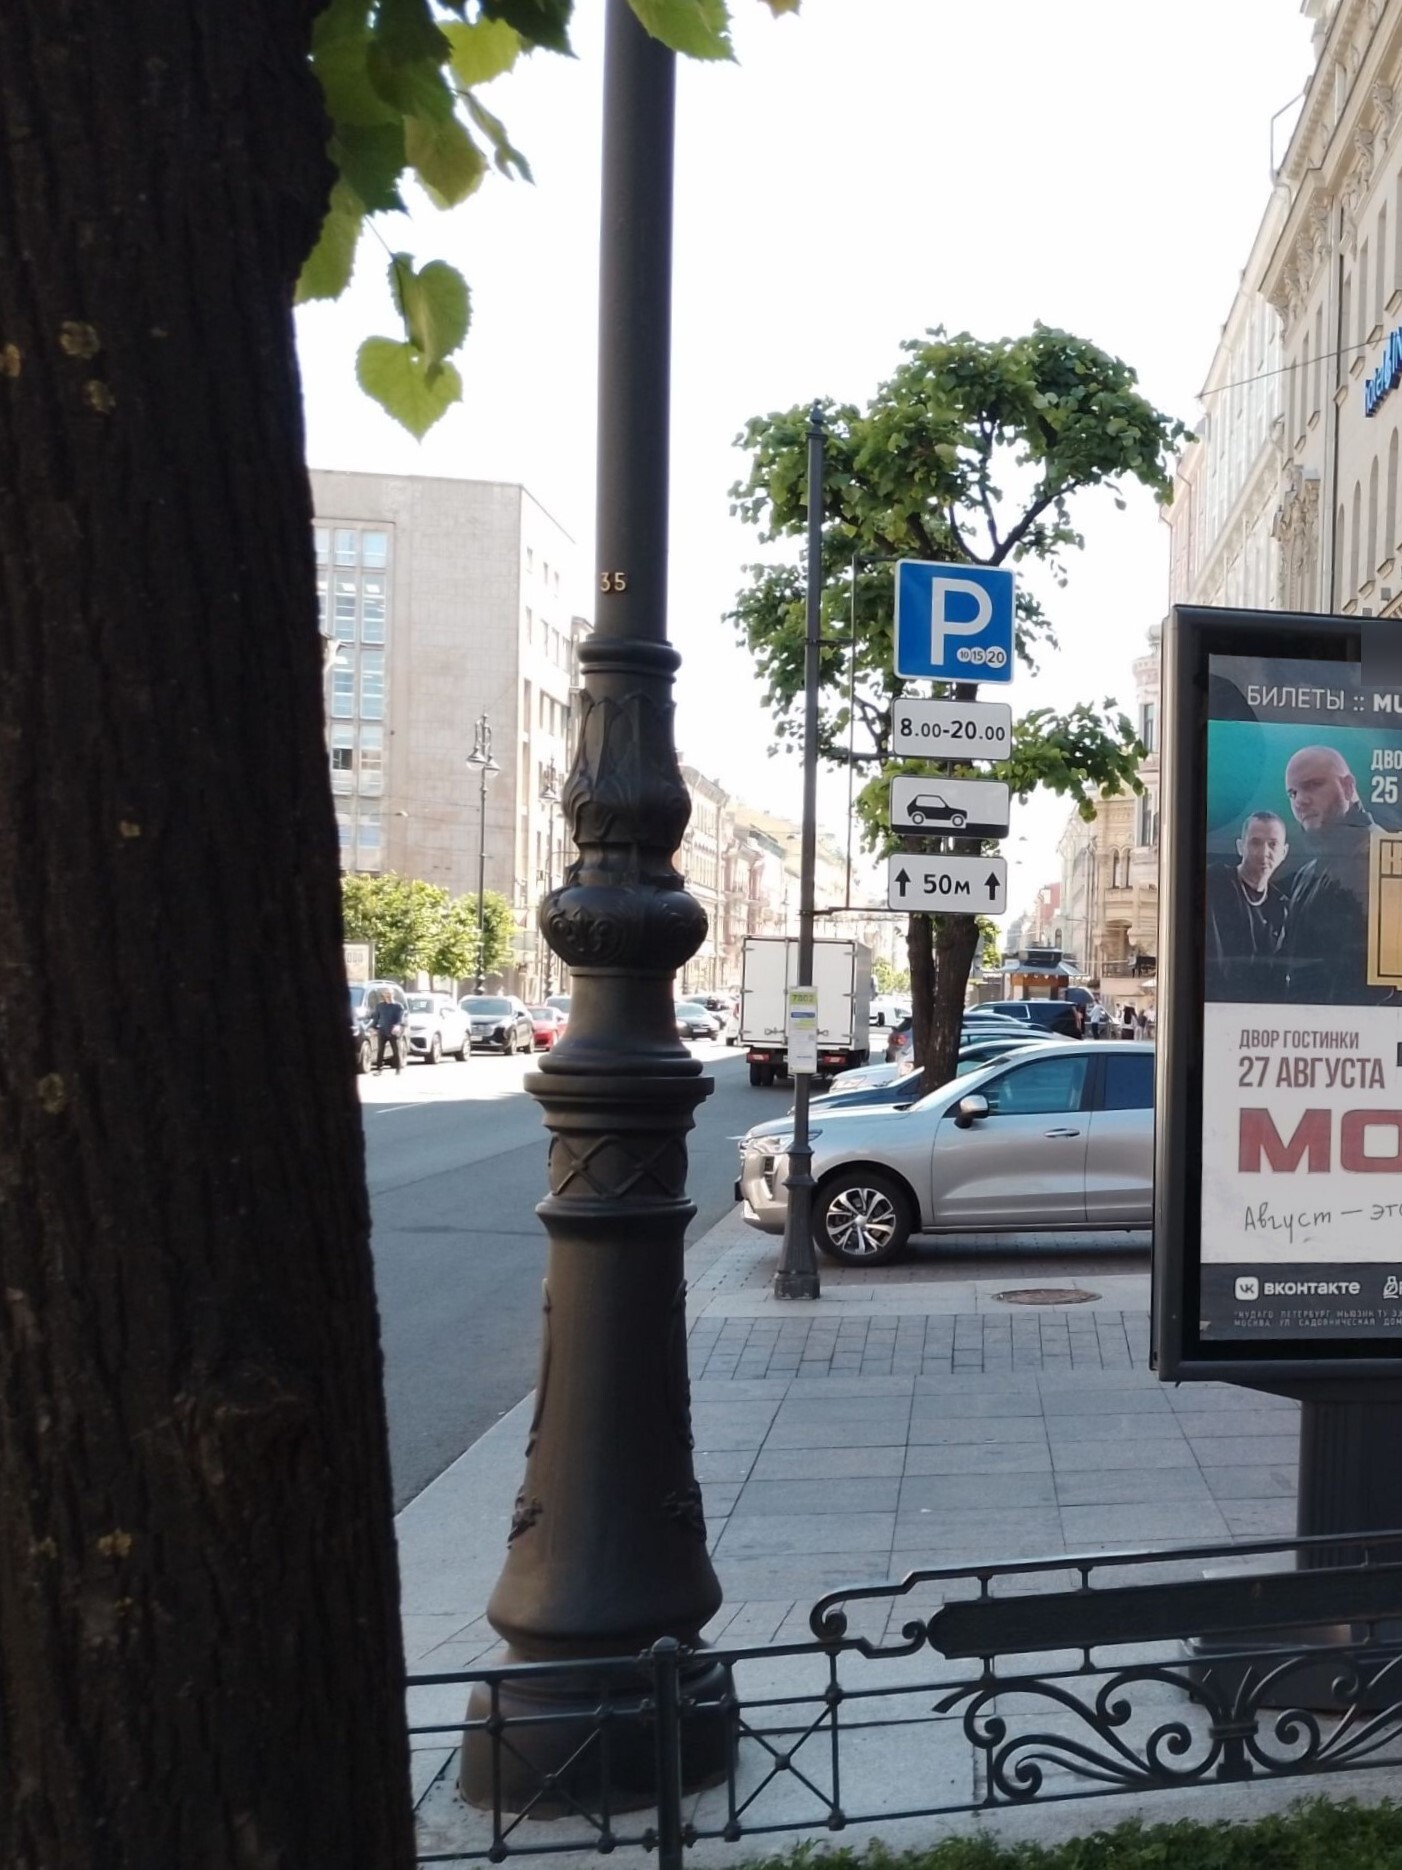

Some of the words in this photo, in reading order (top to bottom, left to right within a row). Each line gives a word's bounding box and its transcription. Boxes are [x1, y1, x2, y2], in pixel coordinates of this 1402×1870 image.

[600, 572, 626, 592] 35
[930, 576, 993, 665] P
[960, 651, 970, 659] 10
[972, 651, 984, 661] 15
[988, 651, 1005, 664] 20
[1247, 685, 1344, 710] БИЛЕТЫ
[900, 718, 1005, 741] 8.00-20.00
[1371, 775, 1398, 804] 25
[1239, 1029, 1280, 1050] ДВОР
[1283, 1030, 1359, 1050] ГОСТИНКИ
[1238, 1056, 1269, 1088] 27
[1276, 1057, 1385, 1089] АВГУСТА
[1244, 1201, 1332, 1244] Август
